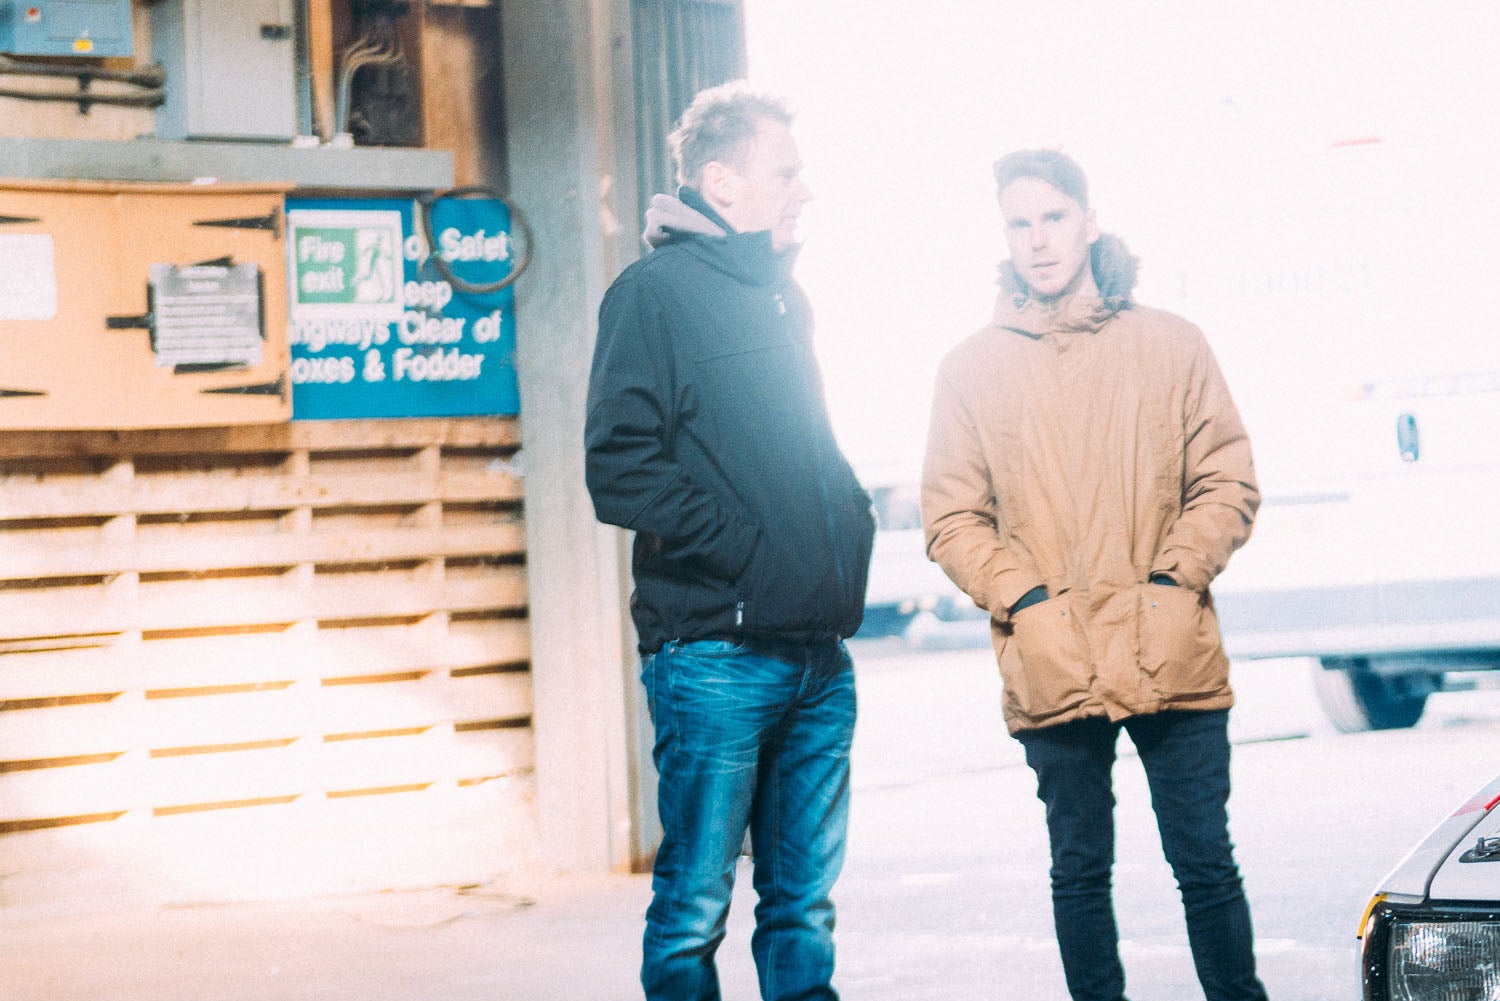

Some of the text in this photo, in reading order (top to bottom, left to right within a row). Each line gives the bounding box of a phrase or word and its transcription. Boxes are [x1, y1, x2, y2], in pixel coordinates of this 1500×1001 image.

[302, 236, 345, 264] Fire
[439, 227, 510, 262] Safet
[303, 266, 345, 293] exit
[404, 281, 453, 313] eep
[399, 310, 465, 345] Clear
[471, 309, 503, 344] of
[291, 347, 485, 384] oxes & Fodder
